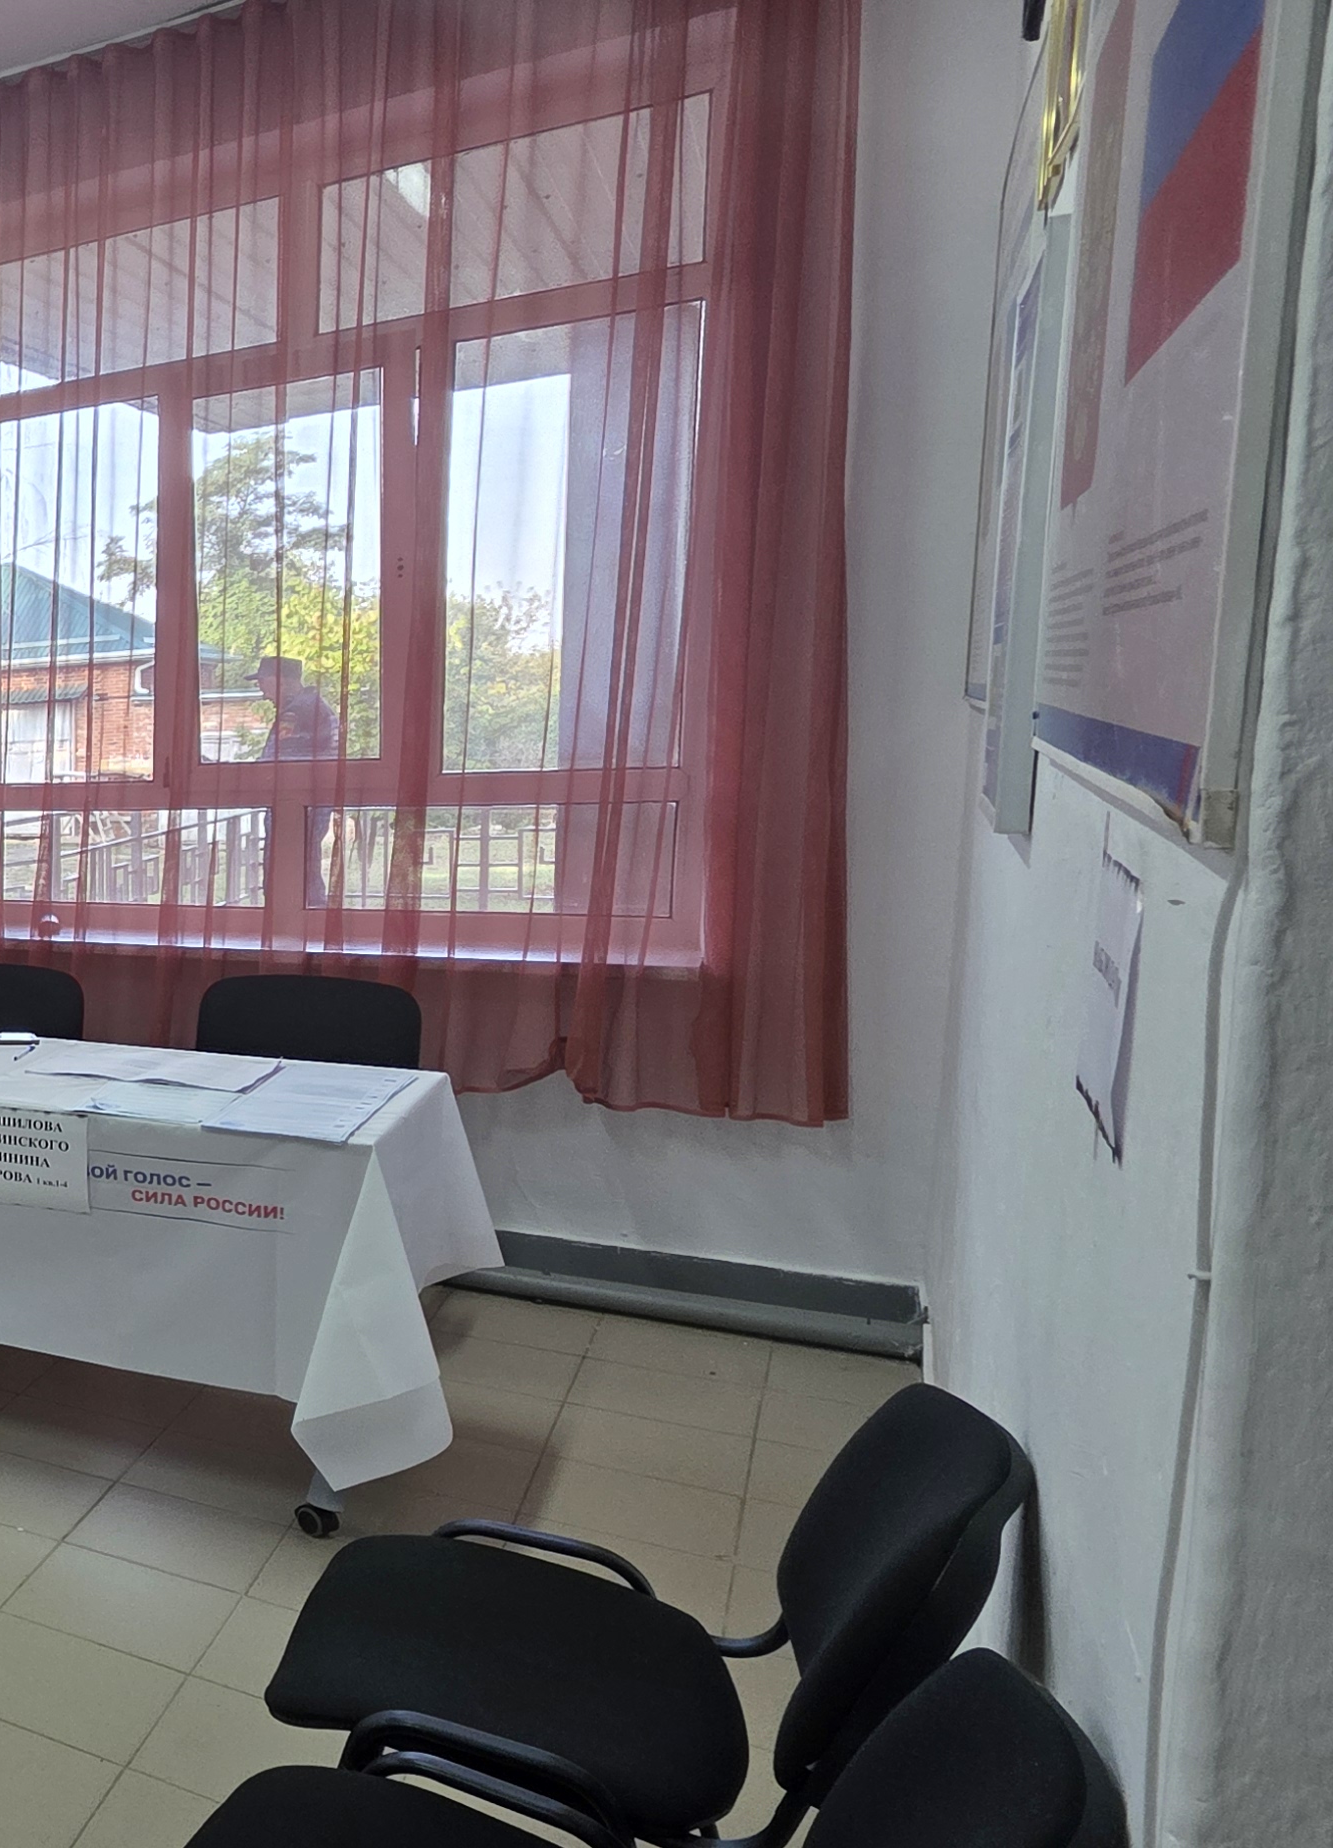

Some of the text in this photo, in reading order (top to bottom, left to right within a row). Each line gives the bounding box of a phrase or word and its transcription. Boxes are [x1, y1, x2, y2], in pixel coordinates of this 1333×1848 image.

[88, 1164, 118, 1181] ОЙ
[123, 1169, 192, 1188] ГОЛОС
[131, 1189, 286, 1220] СИЛА РОССИИ!
